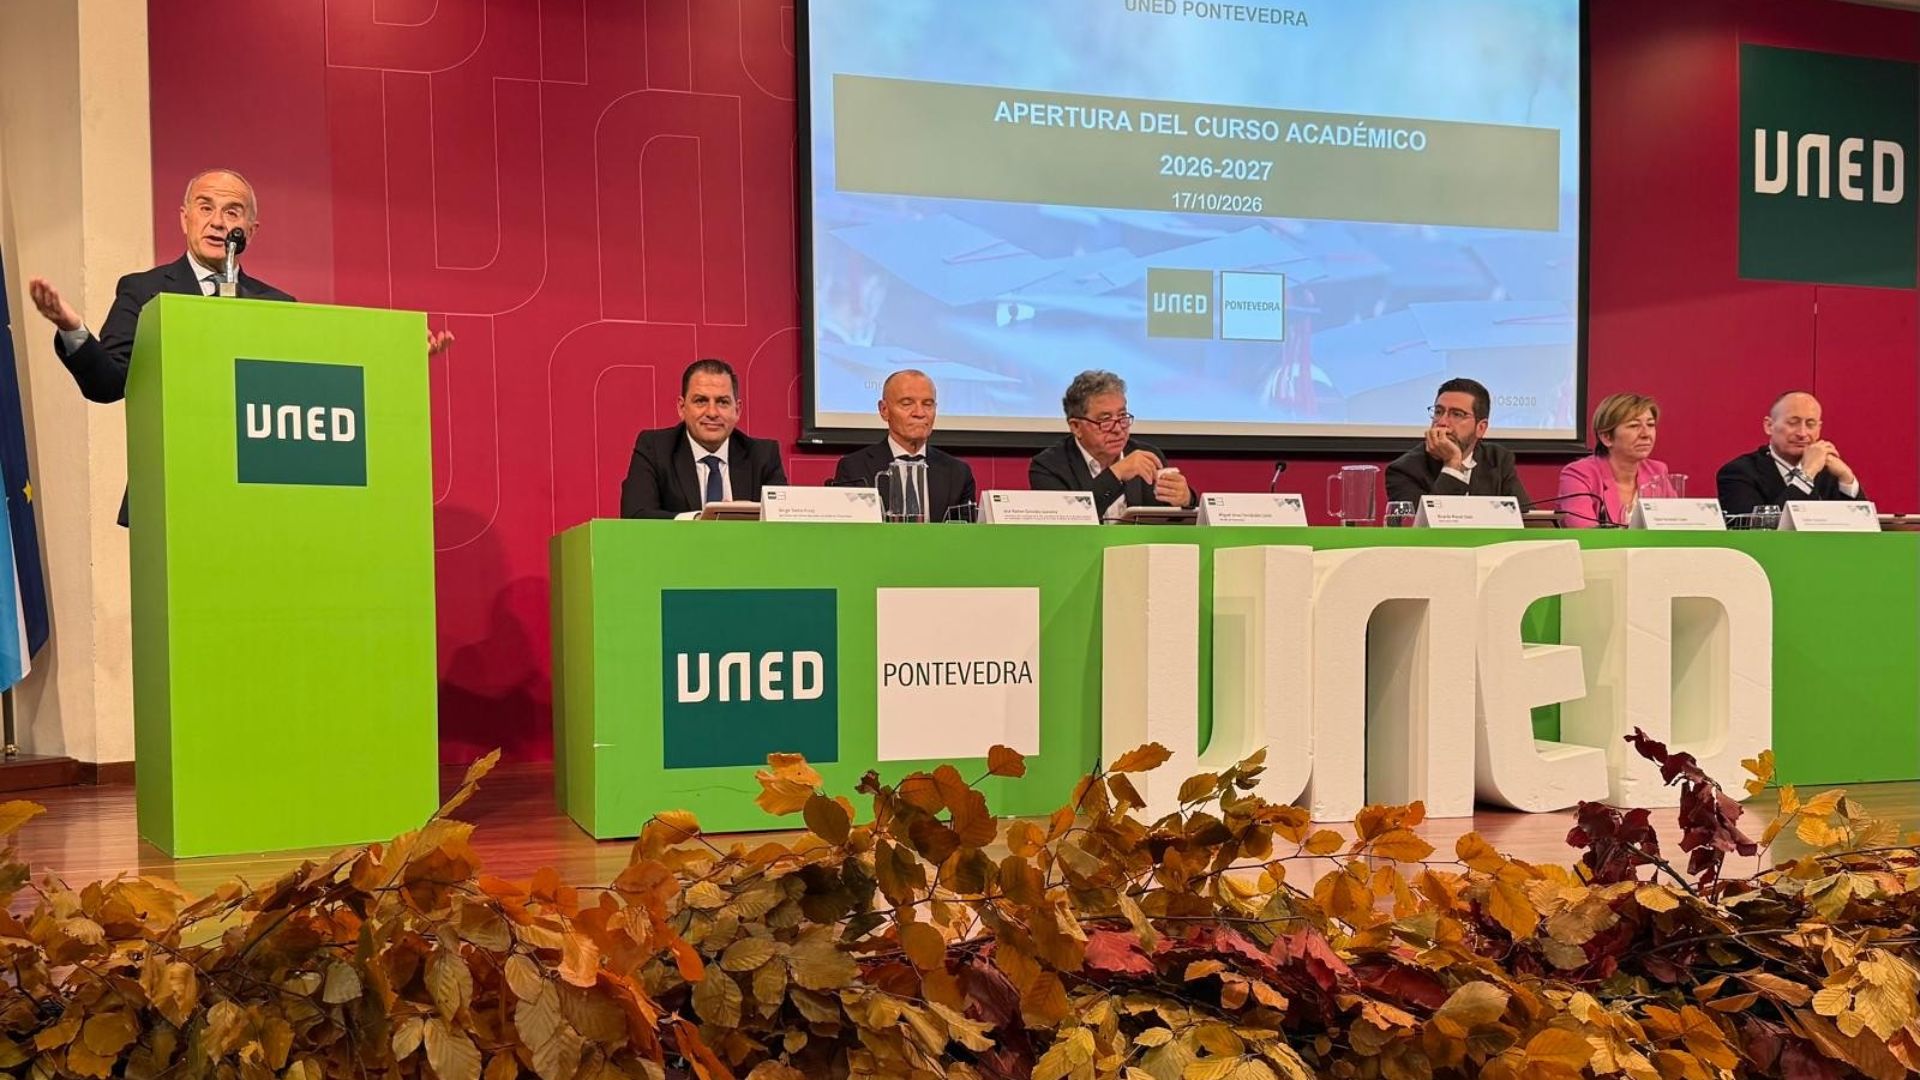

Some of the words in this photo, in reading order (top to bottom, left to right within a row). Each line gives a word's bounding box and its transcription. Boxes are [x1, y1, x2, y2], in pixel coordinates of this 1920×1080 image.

[1125, 0, 1176, 15] UNED
[1183, 1, 1309, 27] PONTEVEDRA
[993, 100, 1133, 133] APERTURA
[1140, 112, 1188, 136] DEL
[1194, 115, 1280, 142] CURSO
[1285, 121, 1427, 153] ACADÉMICO
[1159, 155, 1274, 182] 2026-2027
[1755, 128, 1904, 205] UNED
[1171, 192, 1263, 213] 17/10/2026
[1153, 292, 1208, 314] UNED
[1224, 300, 1281, 312] PONTEVEDRA
[246, 403, 356, 442] UNED
[677, 650, 824, 703] UNED
[883, 660, 1033, 688] PONTEVEDRA
[1102, 539, 1773, 823] UNED
